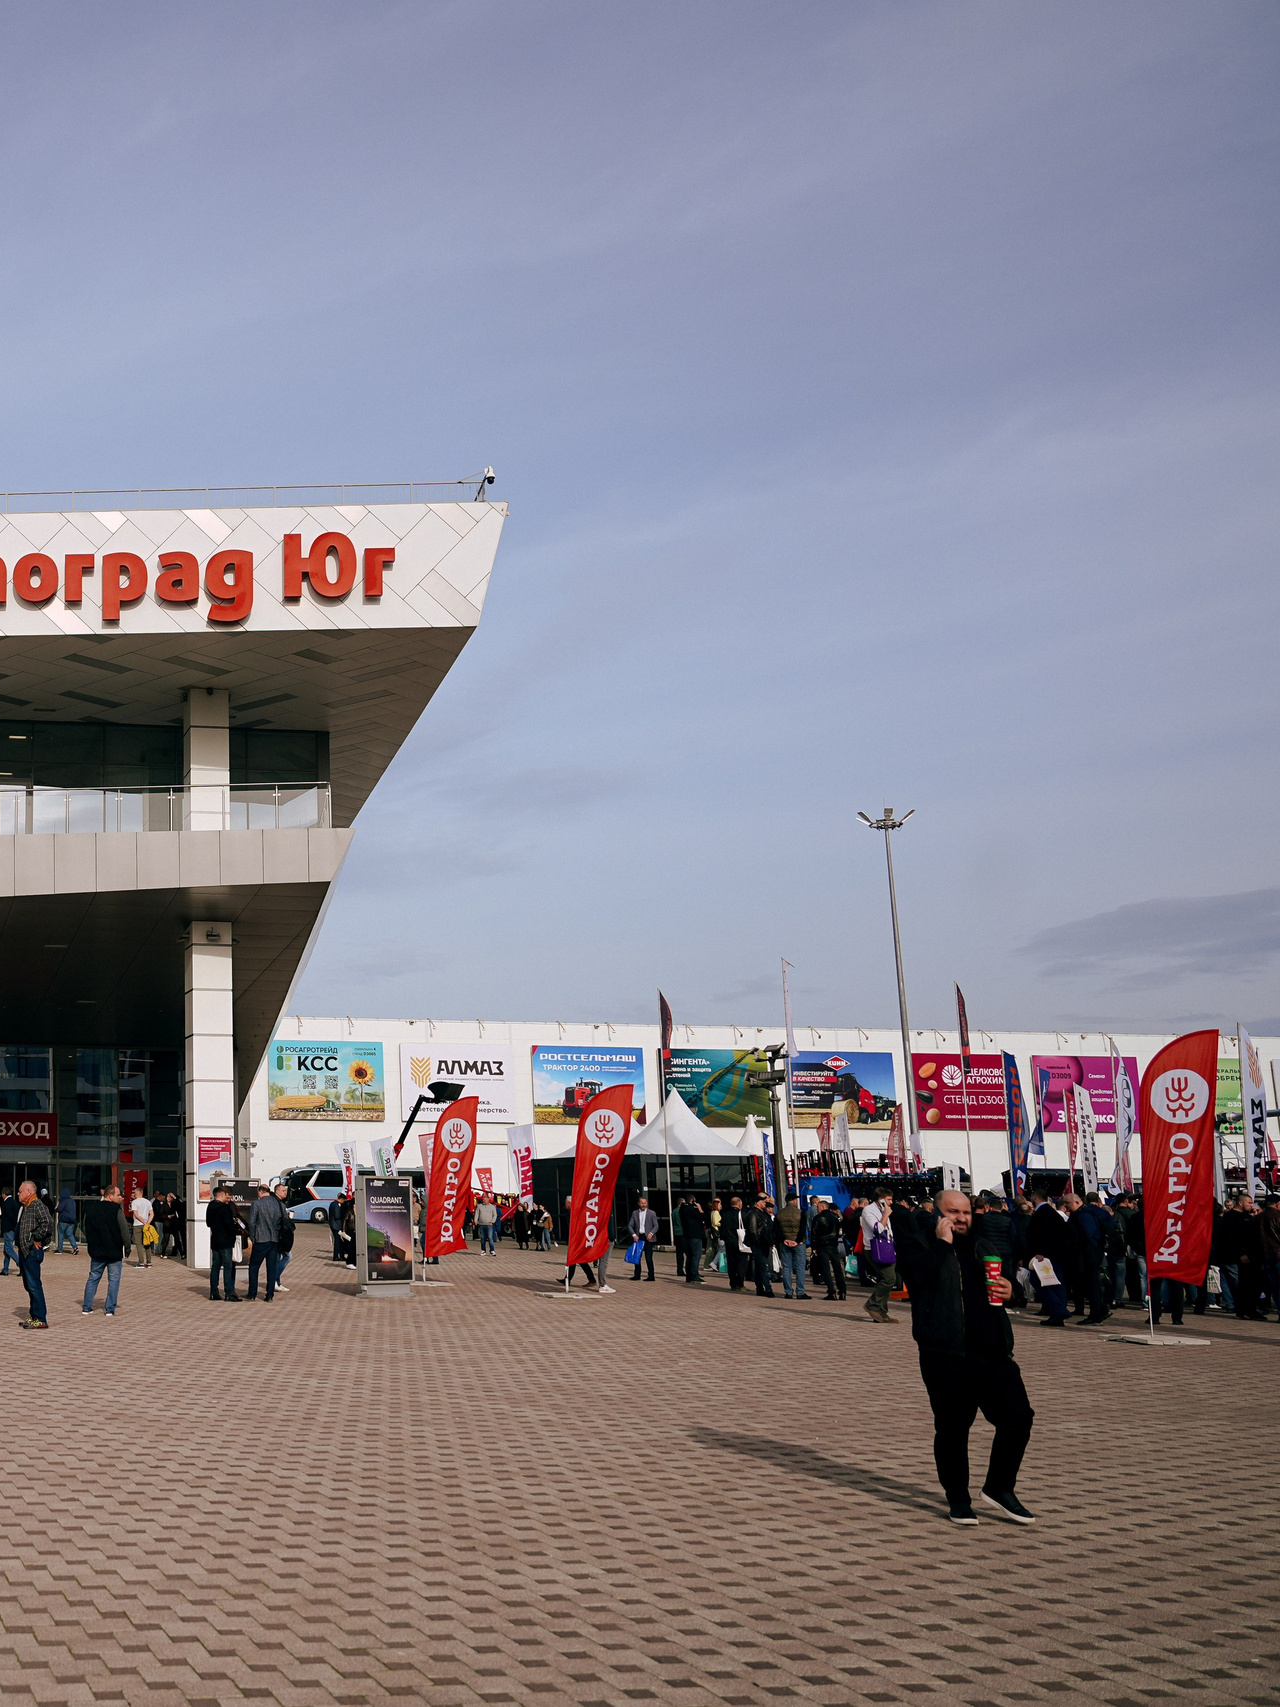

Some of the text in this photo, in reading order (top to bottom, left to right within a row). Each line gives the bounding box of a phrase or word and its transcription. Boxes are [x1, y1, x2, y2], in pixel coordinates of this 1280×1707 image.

[283, 532, 396, 599] Юг
[285, 1046, 338, 1054] РОСАГРОТРЕЙД
[297, 1055, 338, 1071] КСС
[539, 1053, 636, 1063] РОСТСЕЛЬМАШ
[436, 1060, 504, 1075] АЛМАЗ
[580, 1064, 601, 1072] 2400
[1051, 1072, 1072, 1080] D3009
[943, 1095, 977, 1106] СТЕНД
[370, 1196, 404, 1205] QUADRANT.
[440, 1157, 461, 1243] ЮГАГРО
[585, 1153, 610, 1248] ЮГАГРО
[1153, 1132, 1194, 1264] ЮГАГРО
